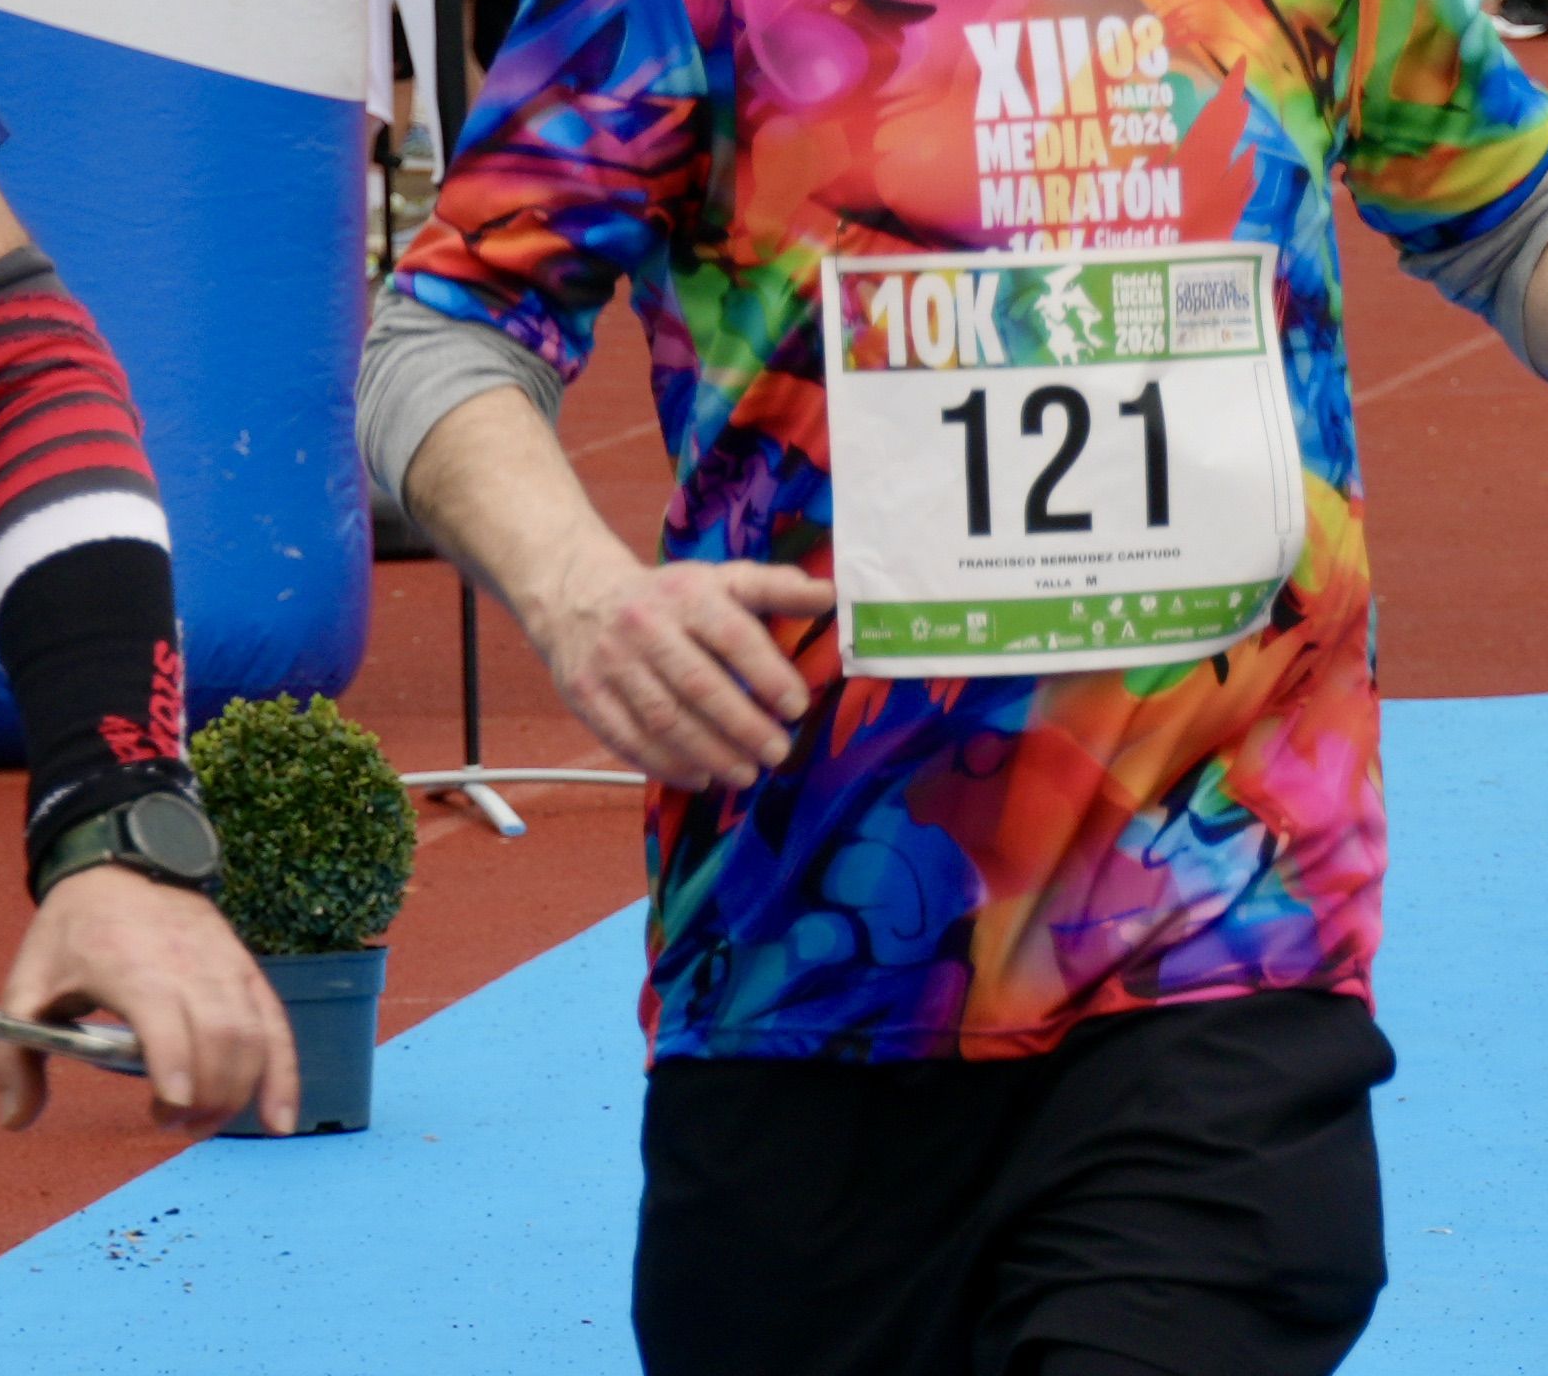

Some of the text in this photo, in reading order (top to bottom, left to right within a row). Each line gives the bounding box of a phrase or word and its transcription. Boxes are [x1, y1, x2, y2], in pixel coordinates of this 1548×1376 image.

[963, 14, 1170, 122] XII 08
[1104, 82, 1174, 110] MARZO
[974, 118, 1110, 174] MEDIA
[1109, 112, 1179, 147] 2026
[978, 156, 1182, 230] MARATÓN
[870, 271, 1006, 370] 10K
[1115, 324, 1166, 356] 2026
[941, 380, 1170, 537] 121
[957, 556, 1037, 570] FRANCISCO
[1034, 574, 1098, 589] TALLA M
